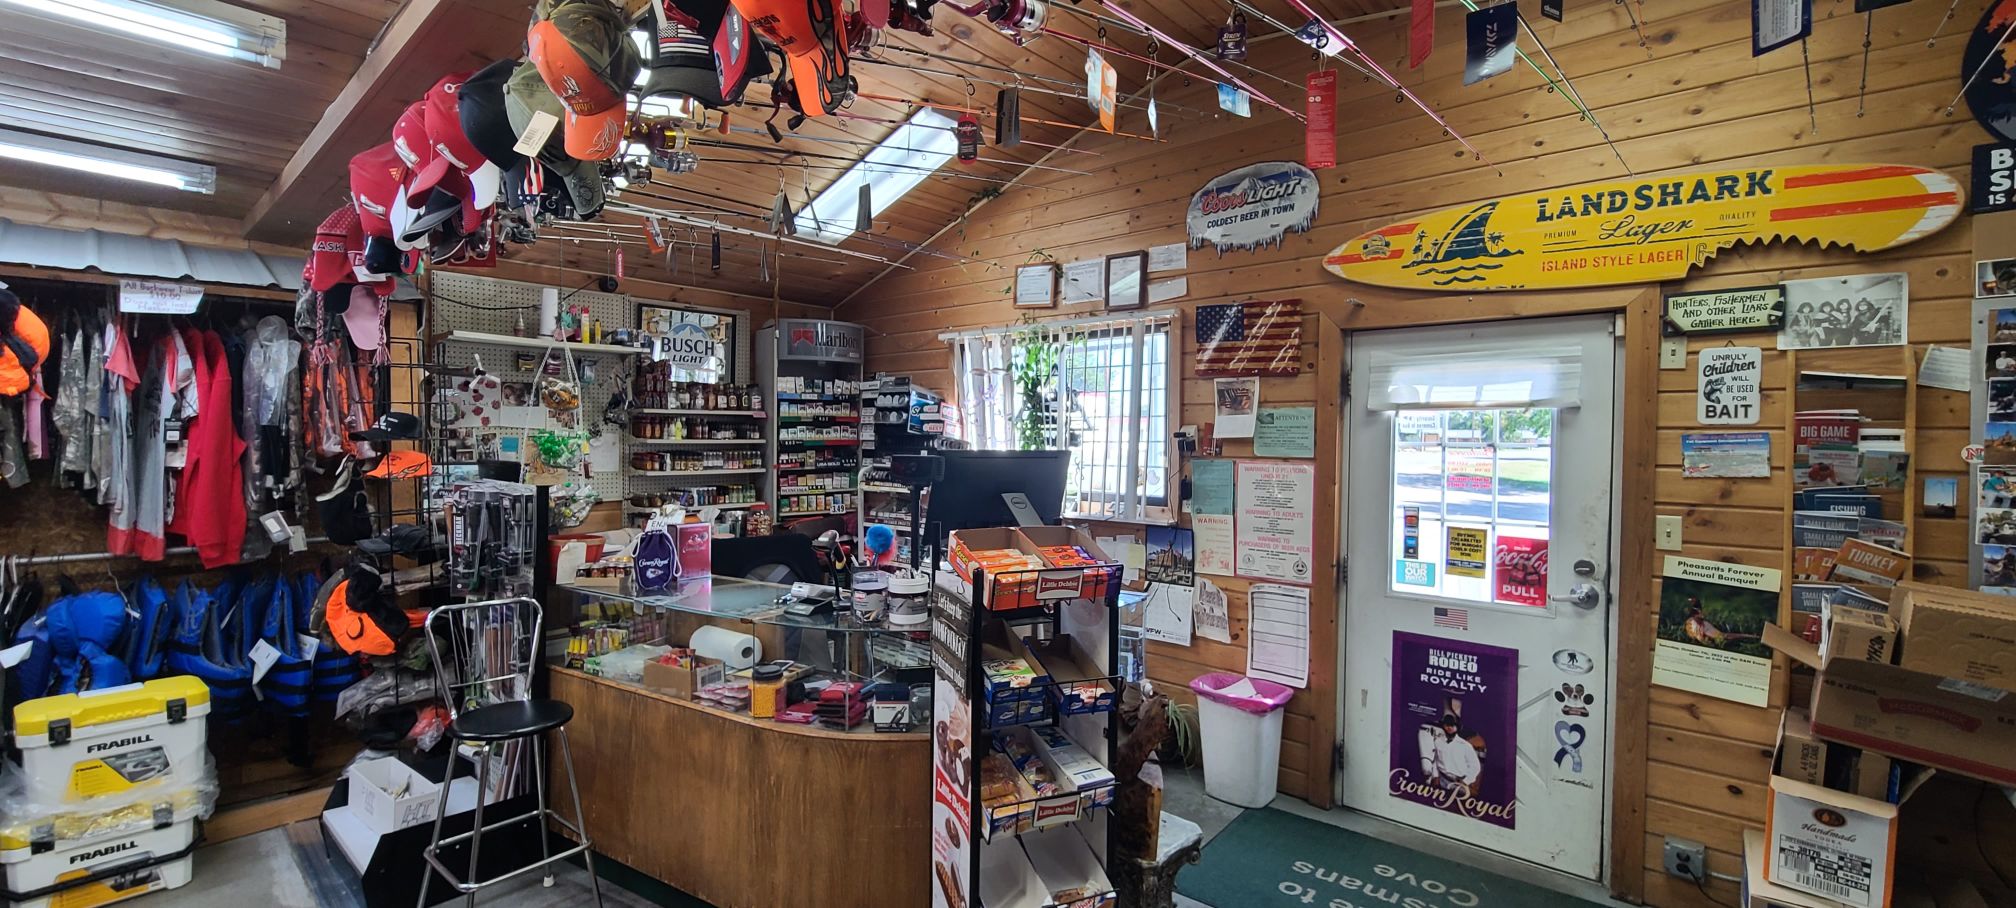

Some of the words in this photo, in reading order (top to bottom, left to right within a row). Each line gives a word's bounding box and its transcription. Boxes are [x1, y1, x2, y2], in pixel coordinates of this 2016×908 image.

[1202, 191, 1246, 215] Coors
[1246, 178, 1301, 204] LIGHT
[1536, 169, 1774, 222] LANDSHARK
[1207, 214, 1238, 229] COLDEST
[1240, 211, 1259, 223] BEER
[1261, 208, 1270, 218] IN
[1272, 203, 1295, 216] TOWN
[1719, 210, 1756, 221] QUALITY
[1544, 229, 1577, 240] PREMIUM
[1599, 214, 1694, 245] Lager
[1542, 259, 1587, 272] ISLAND
[1592, 254, 1633, 268] STYLE
[1639, 249, 1684, 263] LAGER
[1714, 292, 1766, 306] FISHERMEN
[1682, 308, 1702, 318] AND
[1707, 304, 1736, 316] OTHER
[1742, 302, 1770, 314] LIARS
[1690, 318, 1724, 328] GATHER
[660, 336, 715, 354] BUSCH
[672, 355, 704, 365] LIGHT
[1712, 352, 1748, 362] UNRULY
[1703, 360, 1756, 378] Children
[1726, 384, 1736, 394] BE
[1738, 384, 1754, 393] USED
[1704, 404, 1752, 419] BAIT
[1800, 426, 1818, 438] BIG
[1820, 426, 1850, 438] GAME
[1196, 517, 1228, 525] WARNING
[1245, 509, 1270, 517] WARNING
[1848, 548, 1898, 572] TURKEY
[1404, 568, 1427, 576] OUR
[1677, 560, 1725, 573] Pheasants
[1728, 568, 1765, 578] Forever
[1058, 580, 1078, 588] Debbie
[1682, 569, 1715, 580] Annual
[1718, 574, 1758, 586] Banquet
[1502, 584, 1539, 598] PULL
[1428, 656, 1478, 673] RODEO
[1447, 651, 1478, 663] PICKETT
[1426, 668, 1451, 678] RIDE
[1456, 672, 1482, 683] LIKE
[1420, 674, 1488, 694] ROYALTY
[87, 734, 154, 754] FRABILL
[1389, 768, 1447, 801] Crown
[1434, 782, 1516, 819] Royal
[1056, 806, 1076, 815] Debbie
[1800, 822, 1857, 843] Handmade
[70, 840, 138, 865] FRABILL
[1372, 864, 1480, 906] Cove
